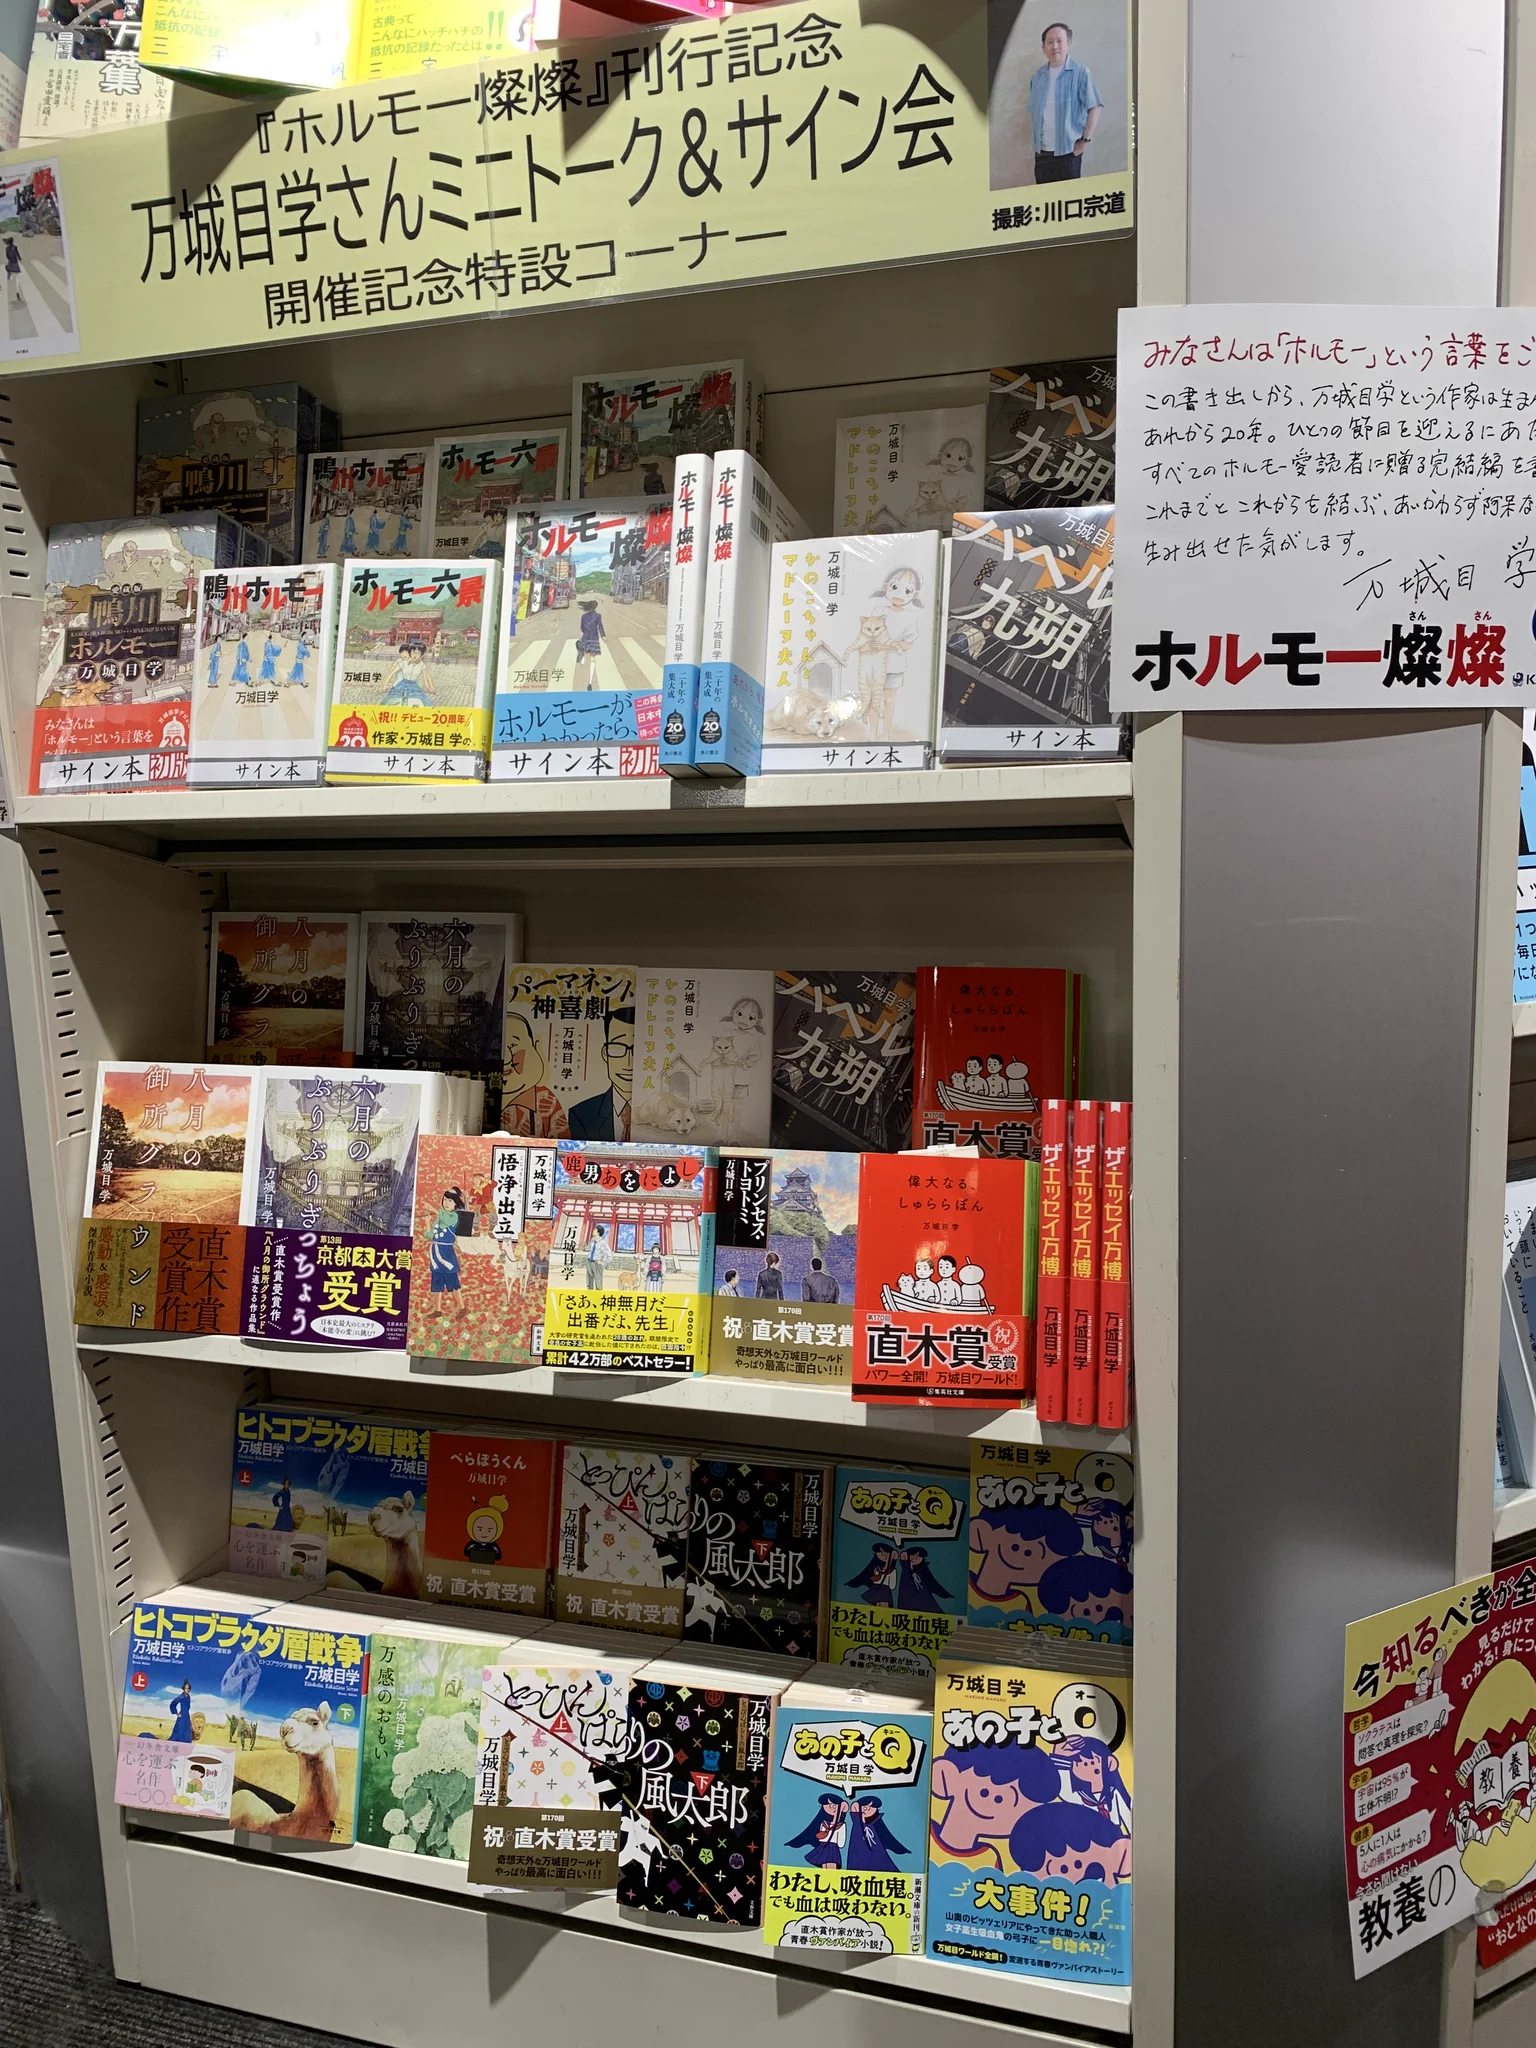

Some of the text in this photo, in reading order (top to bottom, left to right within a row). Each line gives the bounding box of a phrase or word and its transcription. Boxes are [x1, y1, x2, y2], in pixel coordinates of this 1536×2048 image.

[373, 13, 414, 28] 古典って
[256, 12, 844, 155] 『ホルモー燦燦』刊行記念
[264, 221, 787, 330] 開催記念特設コーナー
[887, 424, 900, 482] 万城目学
[676, 471, 697, 565] ホルモー燦燦
[714, 467, 736, 562] ホルモー燦燦
[435, 537, 469, 548] 万城目学
[1145, 527, 1365, 566] 生み出せた気がします。
[203, 574, 323, 614] 鴨川ホルモー
[352, 568, 485, 612] ホルモー六景
[826, 551, 841, 616] 万城目学
[92, 596, 159, 628] 鴨川
[777, 553, 798, 687] マドレーヌ夫人
[801, 551, 819, 680] かのこちゃんと
[951, 577, 1093, 671] 九朔
[70, 637, 177, 662] ホルモー
[674, 623, 685, 663] 万城目学
[712, 621, 724, 660] 万城目学
[1132, 623, 1506, 691] ホルモー燦燦
[79, 658, 163, 682] 万城目学
[344, 672, 382, 683] 万城目学
[513, 668, 564, 684] 万城目学
[235, 691, 279, 704] 万城目学
[45, 717, 95, 730] みなさんは
[499, 693, 632, 737] ホルモーが
[667, 723, 683, 733] 20
[703, 722, 719, 732] 20
[44, 729, 154, 746] 「ホルモー」という言葉を
[1005, 728, 1096, 751] サイン本
[59, 756, 144, 785] サイン本
[235, 761, 301, 781] サイン本
[384, 755, 456, 775] サイン本
[509, 747, 615, 776] サイン本
[822, 746, 903, 768] サイン本
[289, 915, 314, 1005] 八月の
[443, 918, 468, 995] 六月の
[531, 995, 610, 1021] 神喜劇
[683, 979, 696, 1034] 万城目学
[856, 975, 912, 1012] 万城目学
[220, 990, 231, 1038] 万城目学
[368, 1001, 381, 1052] 万城目学
[775, 977, 910, 1057] バベル
[561, 1027, 575, 1080] 万城目学
[775, 1026, 885, 1105] 九朔
[180, 1068, 212, 1167] 八月の
[348, 1076, 378, 1161] 六月の
[99, 1149, 115, 1202] 万城目学
[532, 1154, 548, 1212] 万城目学
[566, 1155, 696, 1191] 鹿男あをによし
[724, 1159, 736, 1201] 万城目学
[261, 1167, 277, 1224] 万城目学
[495, 1152, 520, 1236] 悟浄出立
[739, 1160, 753, 1224] トヨトミ
[899, 1196, 984, 1212] しゅららぼん
[320, 1235, 342, 1244] 第13回
[561, 1226, 578, 1282] 万城目学
[157, 1227, 195, 1332] 受賞作
[191, 1227, 231, 1333] 直木賞
[318, 1270, 402, 1315] 受賞
[777, 1306, 802, 1316] 第170回
[866, 1323, 989, 1370] 直木賞
[1044, 1306, 1058, 1367] 万城目学
[1075, 1309, 1090, 1370] 万城目学
[1105, 1311, 1120, 1373] 万城目学
[736, 1346, 844, 1364] 奇想天外な万城目ワールド
[988, 1355, 1017, 1371] 受賞
[238, 1440, 284, 1457] 万城目学
[450, 1452, 527, 1471] べらぼうくん
[980, 1444, 1051, 1465] 万城目学
[240, 1472, 250, 1483] 上
[467, 1473, 508, 1486] 万城目学
[802, 1474, 820, 1538] 万城目学
[877, 1516, 921, 1529] 万城目学
[562, 1508, 578, 1569] 万城目学
[699, 1538, 805, 1590] 風太郎
[450, 1577, 536, 1604] 直木賞受賞
[591, 1597, 680, 1626] 直木賞受賞
[133, 1607, 364, 1669] ヒトコブラクダ層戦争
[133, 1638, 185, 1658] 万城目学
[1478, 1617, 1535, 1654] 見るだけで
[134, 1675, 145, 1688] 上
[304, 1665, 360, 1685] 万城目学
[947, 1674, 1026, 1698] 万城目学
[374, 1645, 396, 1760] 万感のおもい
[1075, 1690, 1097, 1700] オー
[340, 1708, 352, 1720] 下
[394, 1698, 408, 1751] 万城目学
[556, 1718, 568, 1730] 上
[1358, 1718, 1401, 1743] ソクラテスは
[747, 1700, 768, 1772] 万城目学
[135, 1771, 161, 1787] 名作
[478, 1737, 500, 1806] 万城目学
[695, 1776, 709, 1790] 下
[825, 1762, 875, 1775] 万城目学
[1352, 1771, 1368, 1786] 宇宙
[1479, 1767, 1496, 1794] 教
[1509, 1752, 1523, 1780] 養
[634, 1766, 749, 1830] 風太郎
[541, 1814, 565, 1822] 第170回
[1354, 1827, 1370, 1842] 健康
[514, 1827, 618, 1852] 直木賞受賞
[497, 1854, 602, 1868] 奇想天外な万城目ワールド
[769, 1871, 914, 1900] わたし、吸血鬼。
[769, 1895, 912, 1919] でも血は吸わない。
[1359, 1864, 1456, 1953] 教養の
[800, 1925, 874, 1938] 直木賞作家が放つ
